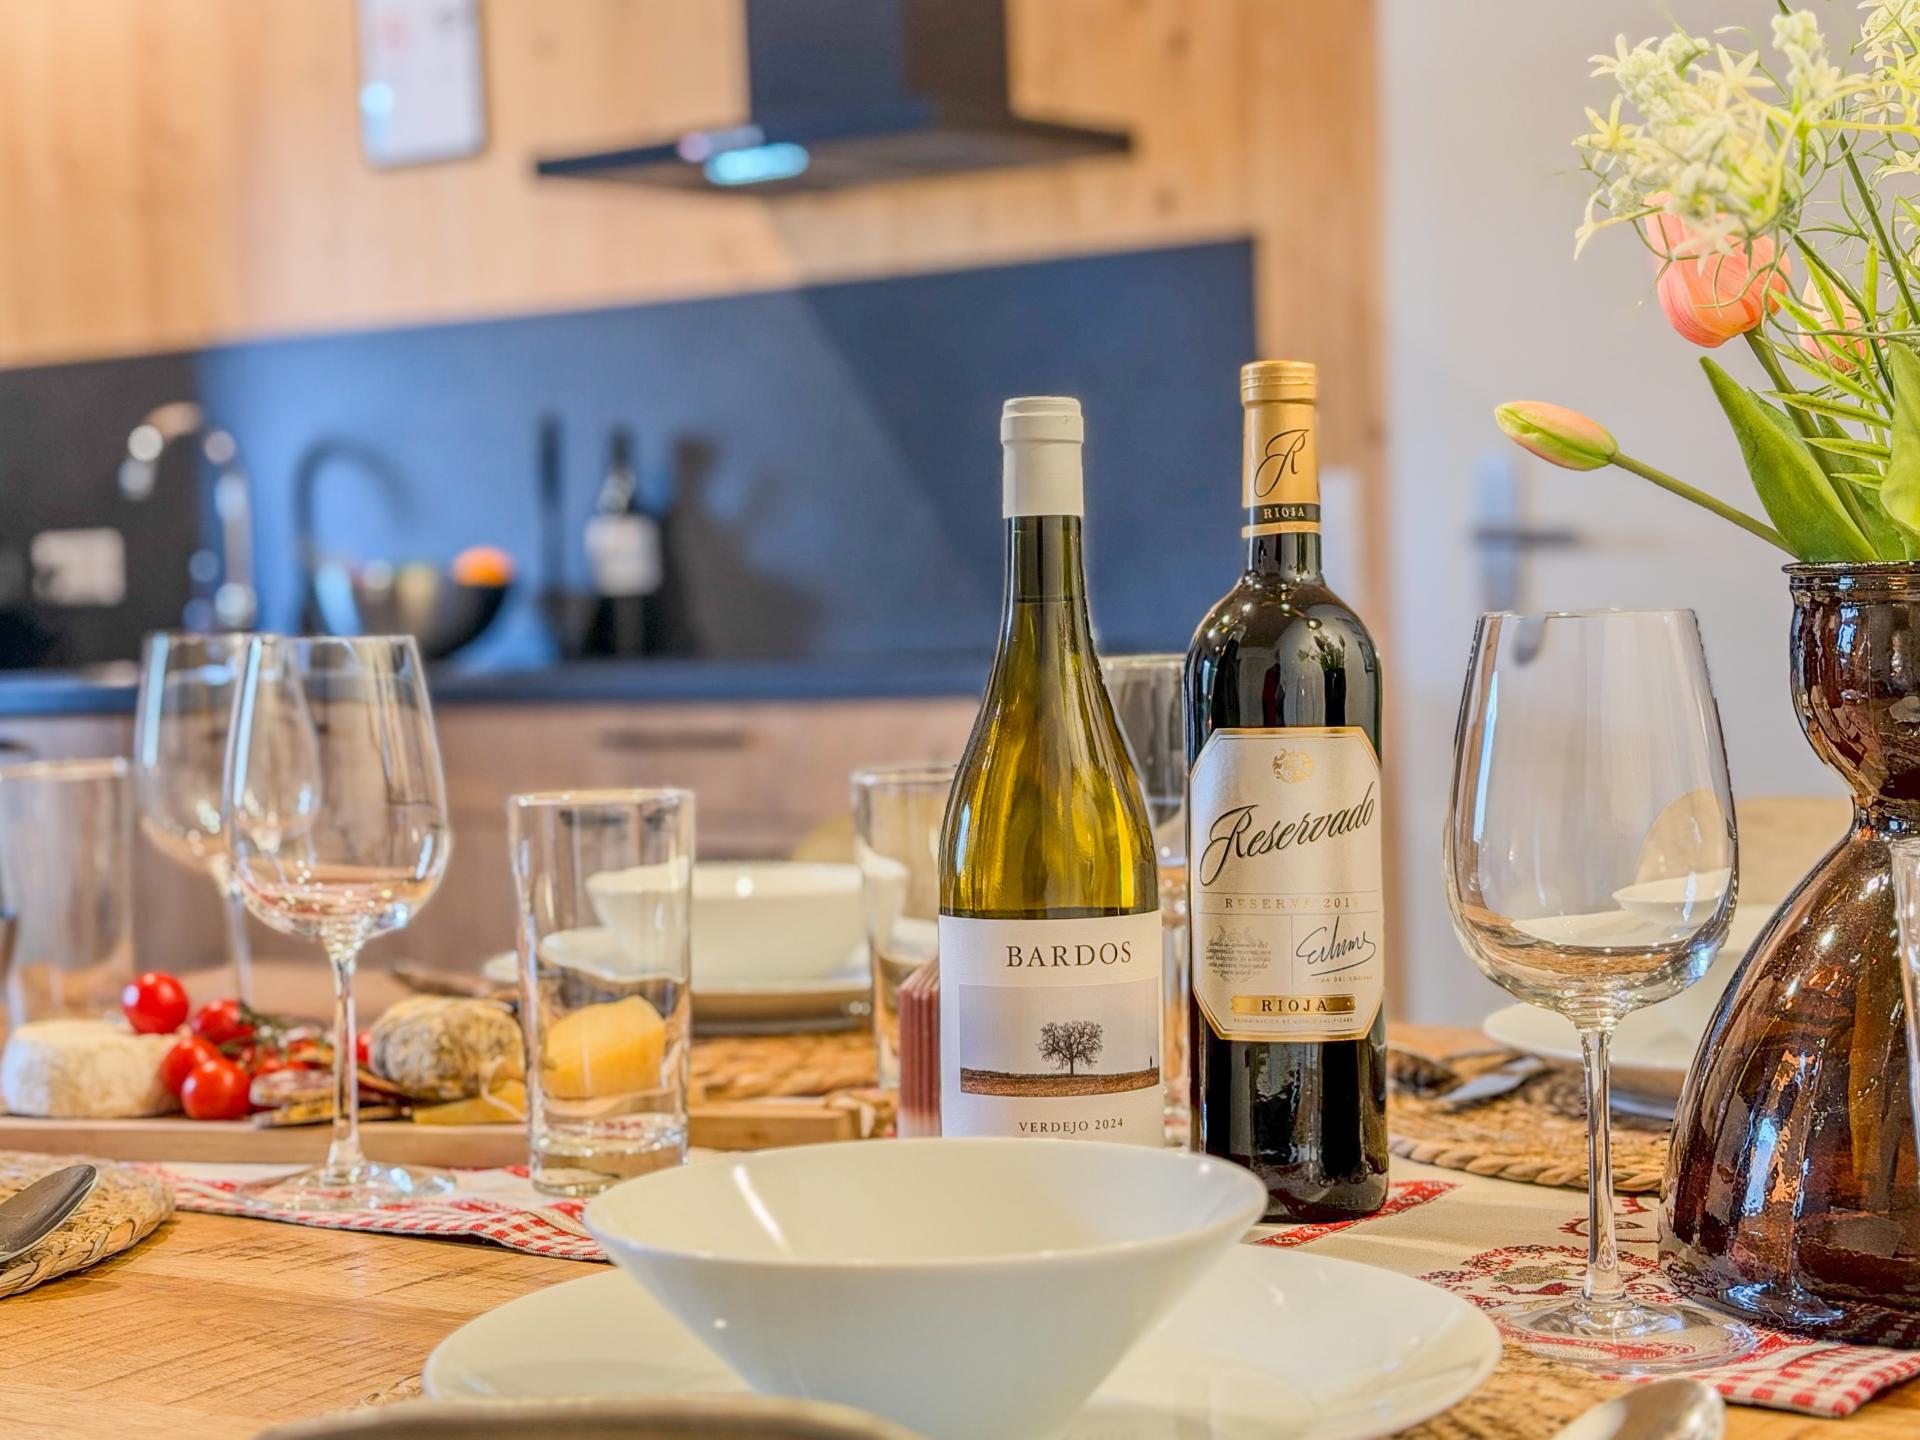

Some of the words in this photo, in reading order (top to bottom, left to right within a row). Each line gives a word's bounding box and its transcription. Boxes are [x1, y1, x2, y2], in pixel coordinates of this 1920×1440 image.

[1263, 506, 1305, 519] RIOJA
[1199, 780, 1376, 887] Reservado
[1006, 941, 1132, 968] BARDOS
[1261, 999, 1329, 1013] RIOJA
[1018, 1120, 1089, 1134] VERDEJO
[1094, 1118, 1124, 1131] 2024
